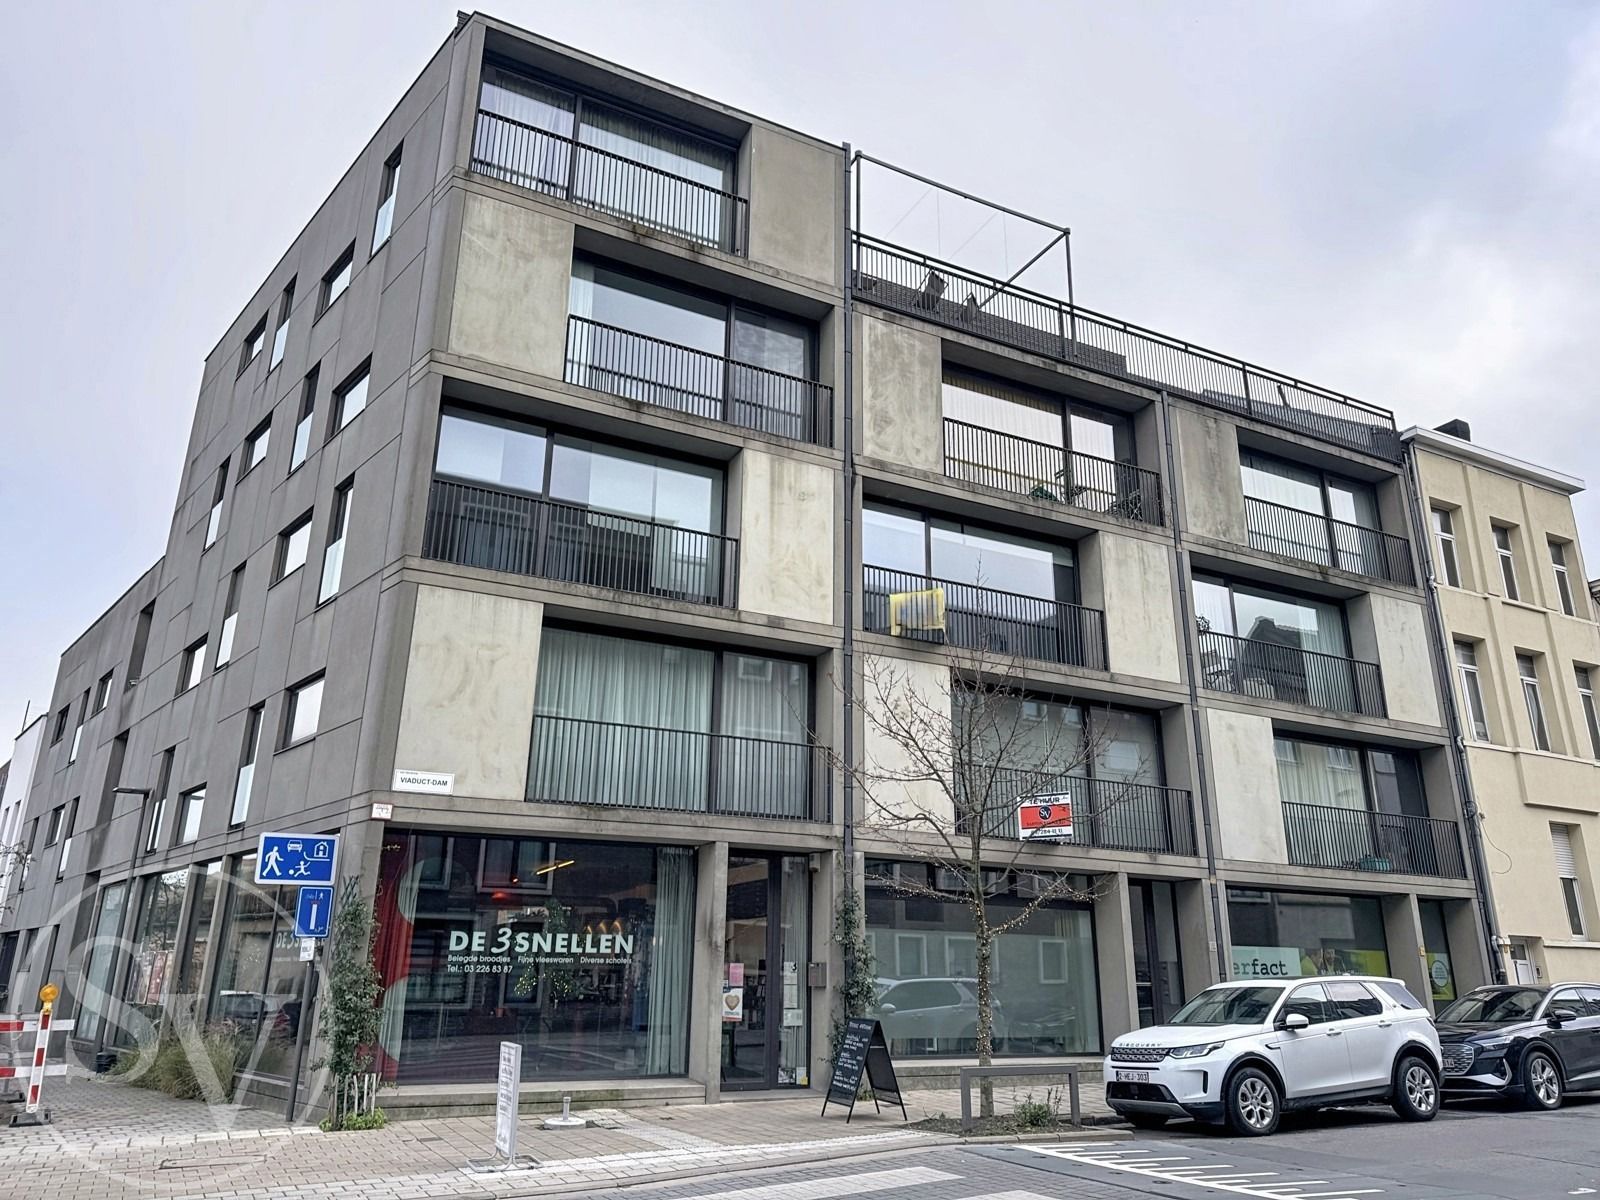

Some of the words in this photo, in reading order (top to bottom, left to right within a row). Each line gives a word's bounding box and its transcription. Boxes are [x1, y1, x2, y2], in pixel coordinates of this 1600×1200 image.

[400, 777, 448, 786] VIADUCT-DAM
[1040, 809, 1051, 818] SV
[450, 931, 486, 952] DE
[490, 927, 512, 954] 3
[514, 932, 634, 954] SNELLEN
[447, 954, 478, 964] Belegde
[479, 954, 511, 964] broodjes
[517, 956, 534, 965] Fijne
[535, 956, 574, 964] vleeswaren
[580, 956, 604, 964] Diverse
[605, 957, 632, 965] schotels
[447, 965, 463, 973] Tel.:
[464, 965, 474, 973] 03
[475, 965, 490, 973] 226
[491, 965, 502, 973] 83
[503, 965, 513, 974] 87
